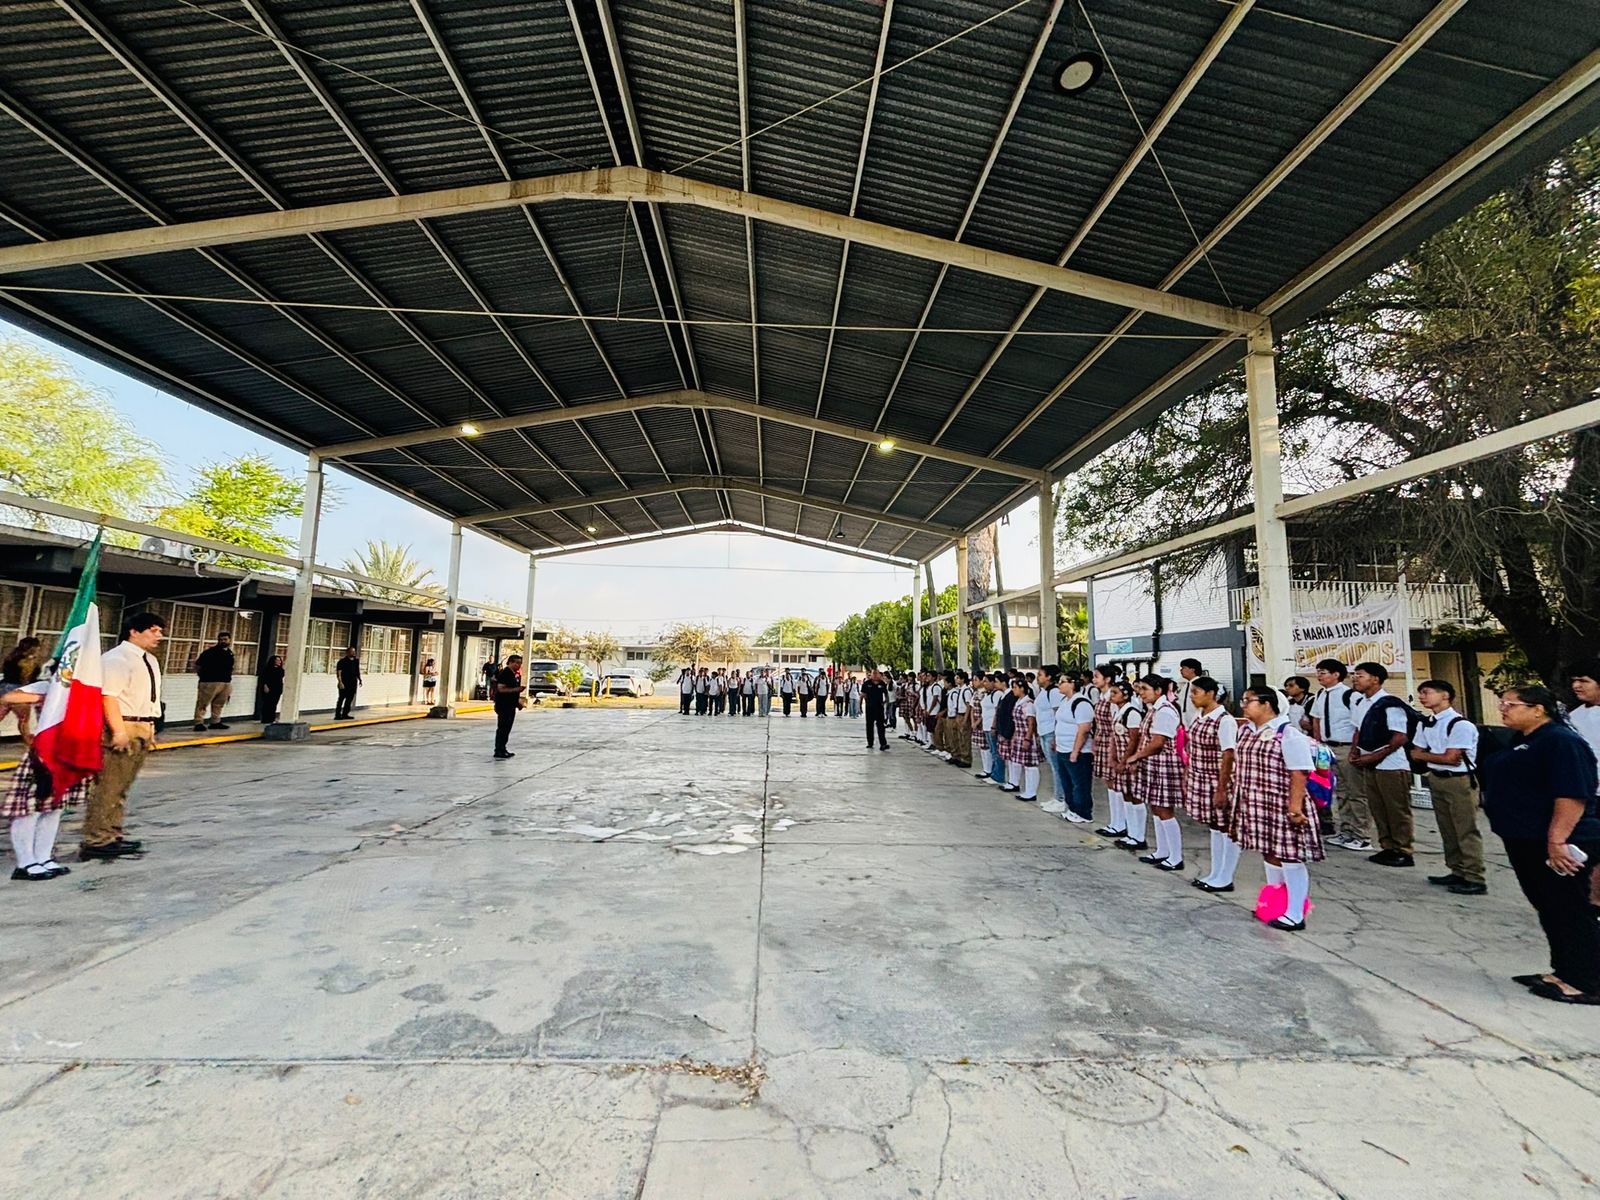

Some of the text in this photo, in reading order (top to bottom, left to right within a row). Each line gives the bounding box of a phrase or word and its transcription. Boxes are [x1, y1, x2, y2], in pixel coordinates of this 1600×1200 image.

[1303, 622, 1334, 641] MARÍA
[1335, 622, 1360, 638] LUIS
[1362, 618, 1394, 636] MORA
